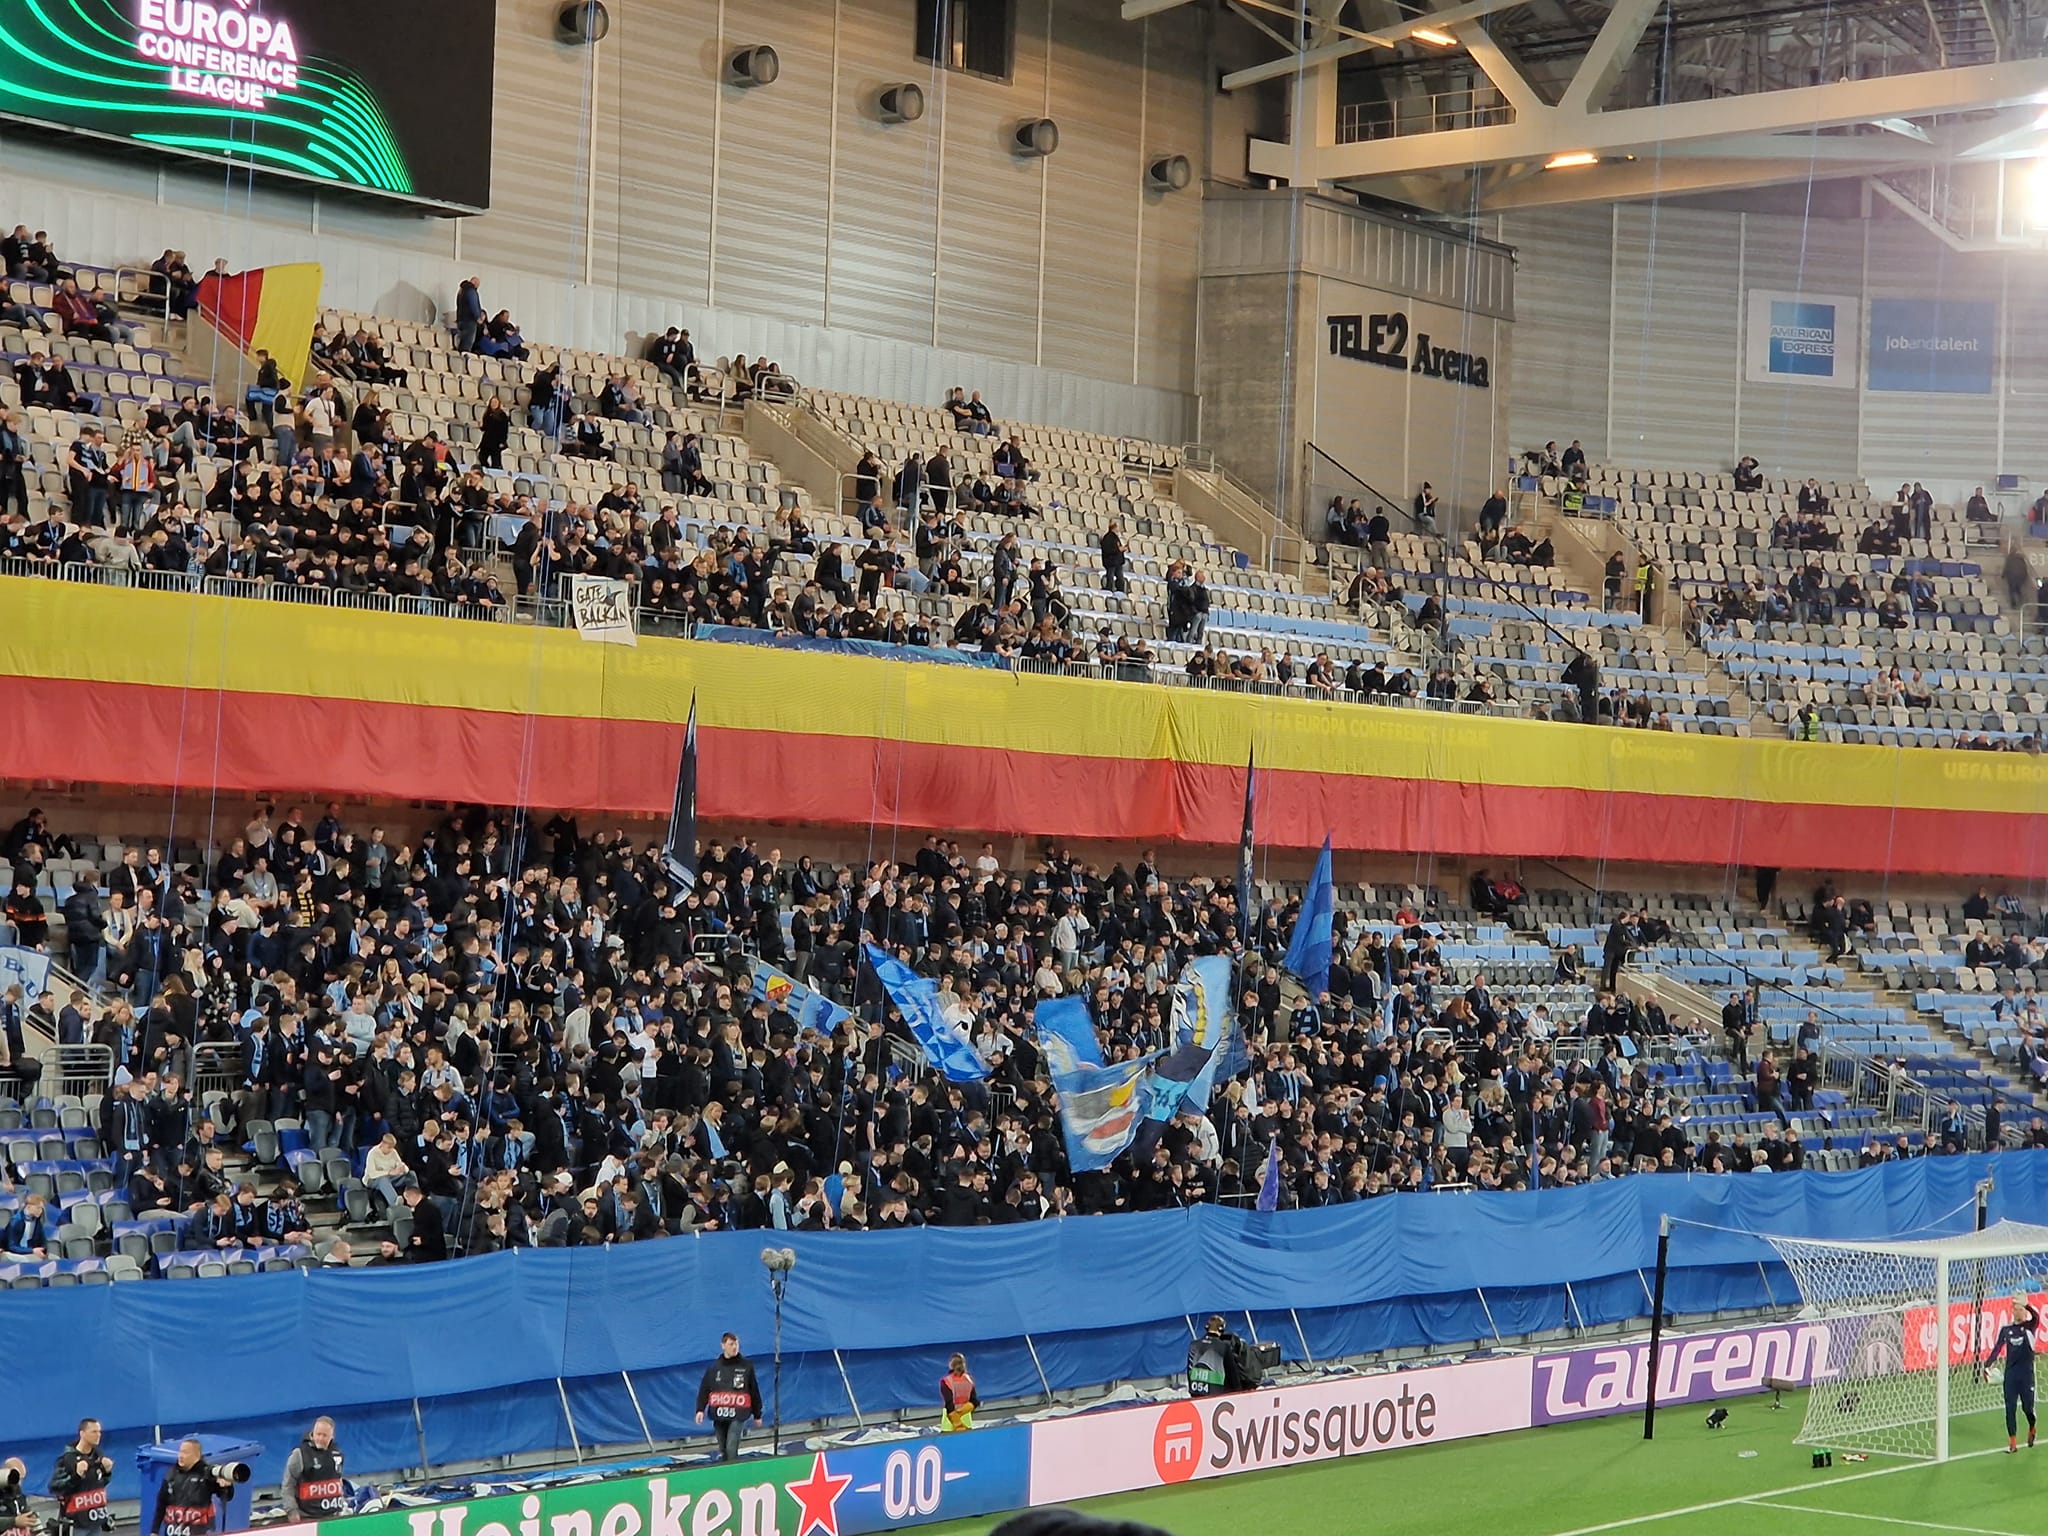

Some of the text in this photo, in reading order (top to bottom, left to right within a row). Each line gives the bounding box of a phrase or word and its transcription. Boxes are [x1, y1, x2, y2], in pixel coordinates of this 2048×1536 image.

[138, 0, 298, 62] EUROPA
[137, 31, 298, 89] CONFERENCE
[1770, 327, 1832, 341] AMERICAN
[1886, 335, 1979, 352] jobandtalent
[1327, 312, 1489, 387] TELE2 Arena
[1783, 341, 1835, 355] EXPRESS
[1943, 759, 1994, 781] UEFA
[1191, 1381, 1209, 1393] 054
[710, 1393, 746, 1406] PHOTO
[1210, 1383, 1436, 1469] Swissquote
[884, 1445, 942, 1520] 0.0
